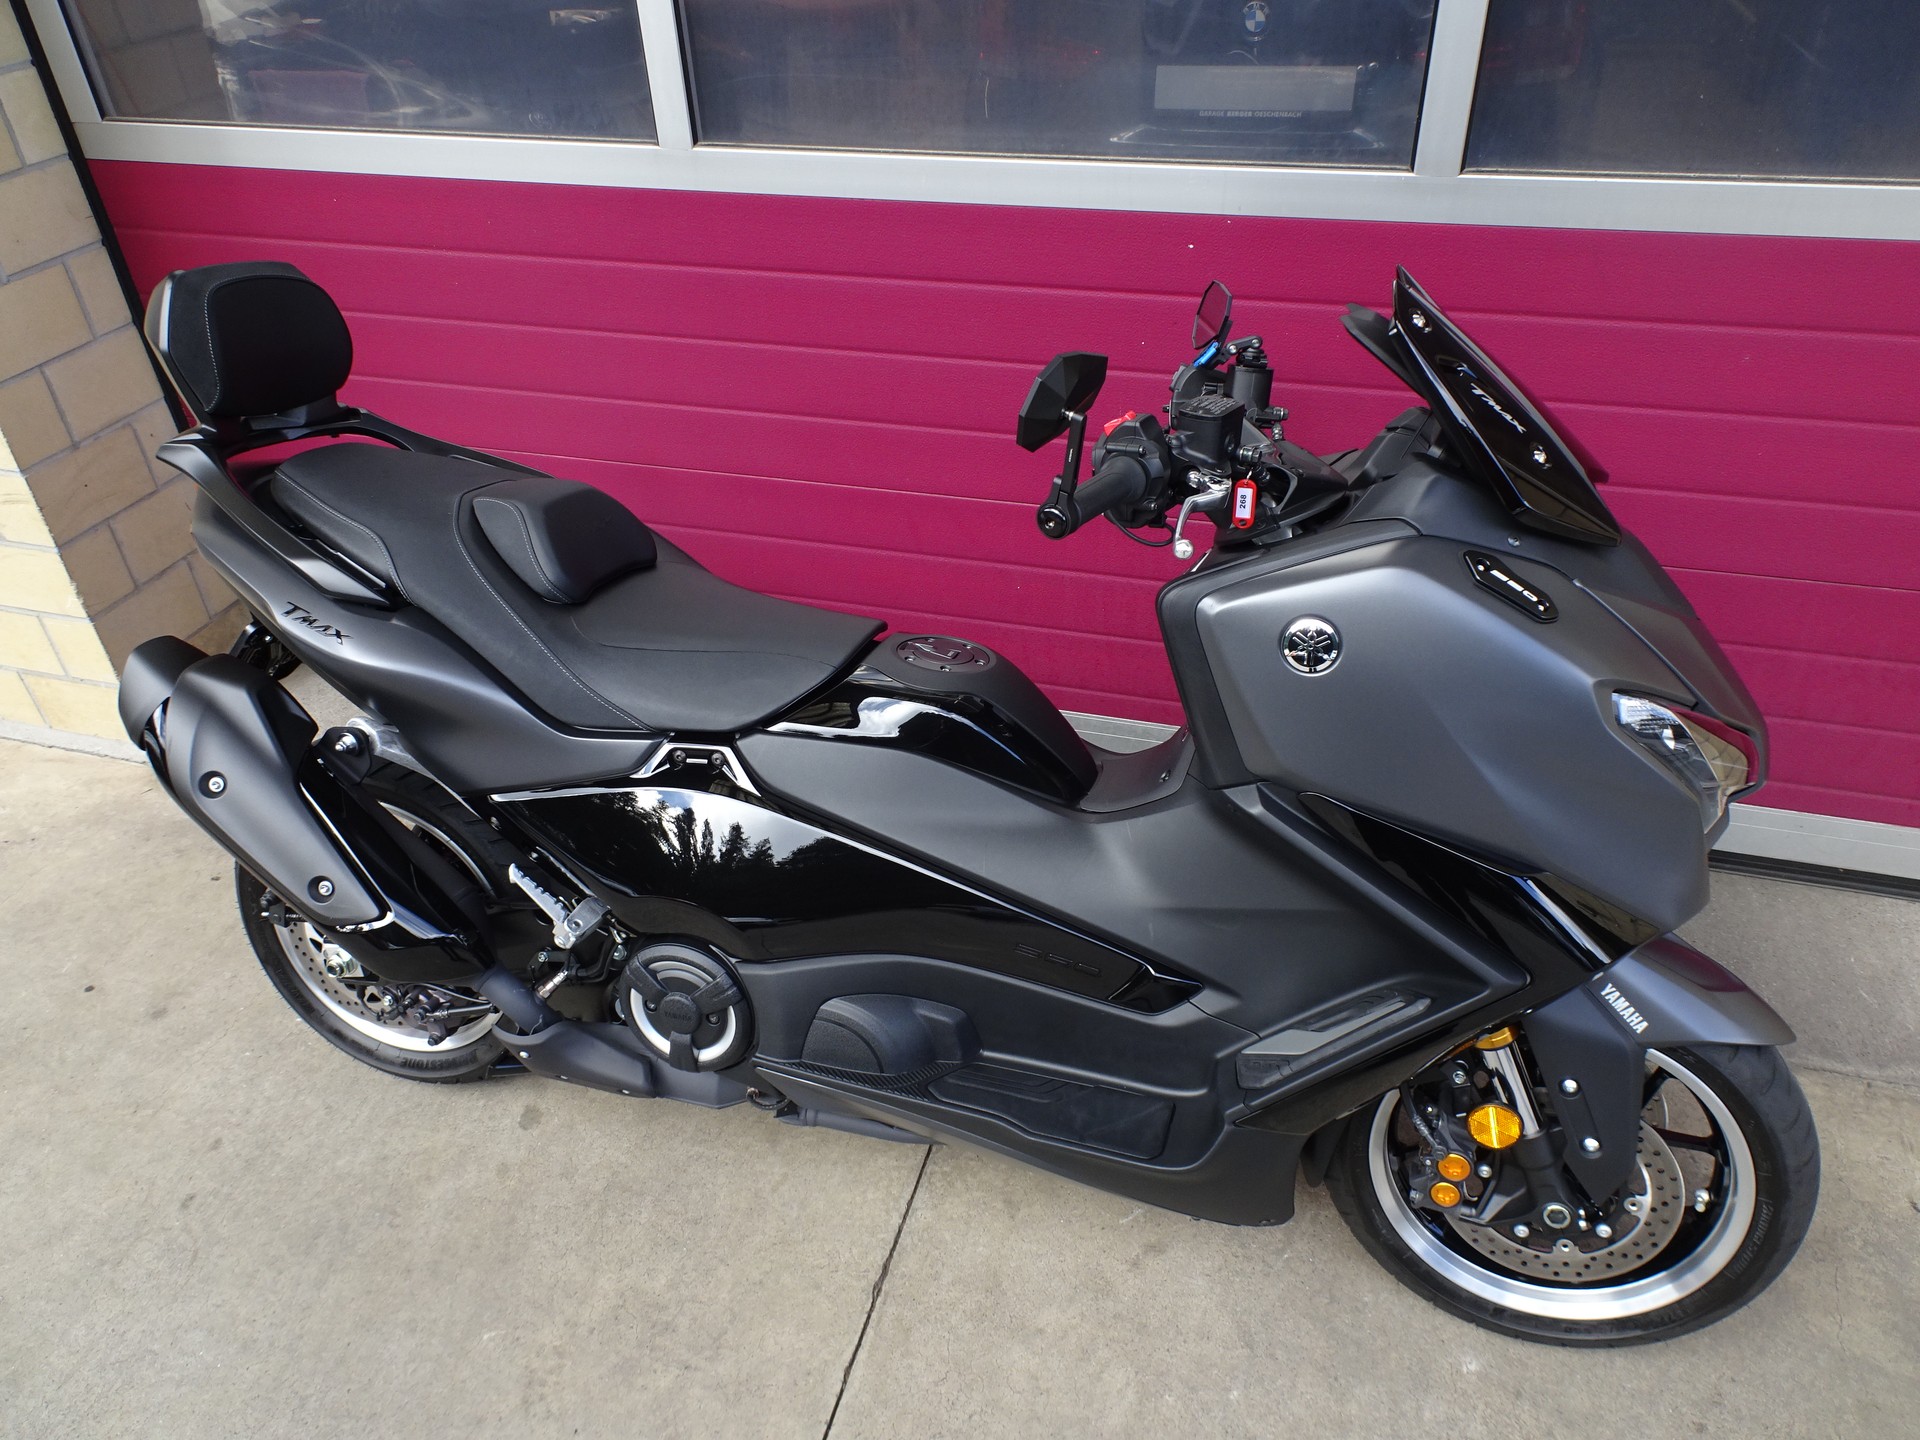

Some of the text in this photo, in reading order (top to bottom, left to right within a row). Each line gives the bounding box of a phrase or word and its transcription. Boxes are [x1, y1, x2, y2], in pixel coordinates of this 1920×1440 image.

[1239, 494, 1247, 509] 268
[281, 601, 354, 645] TMAX
[1600, 982, 1649, 1034] YAMAHA
